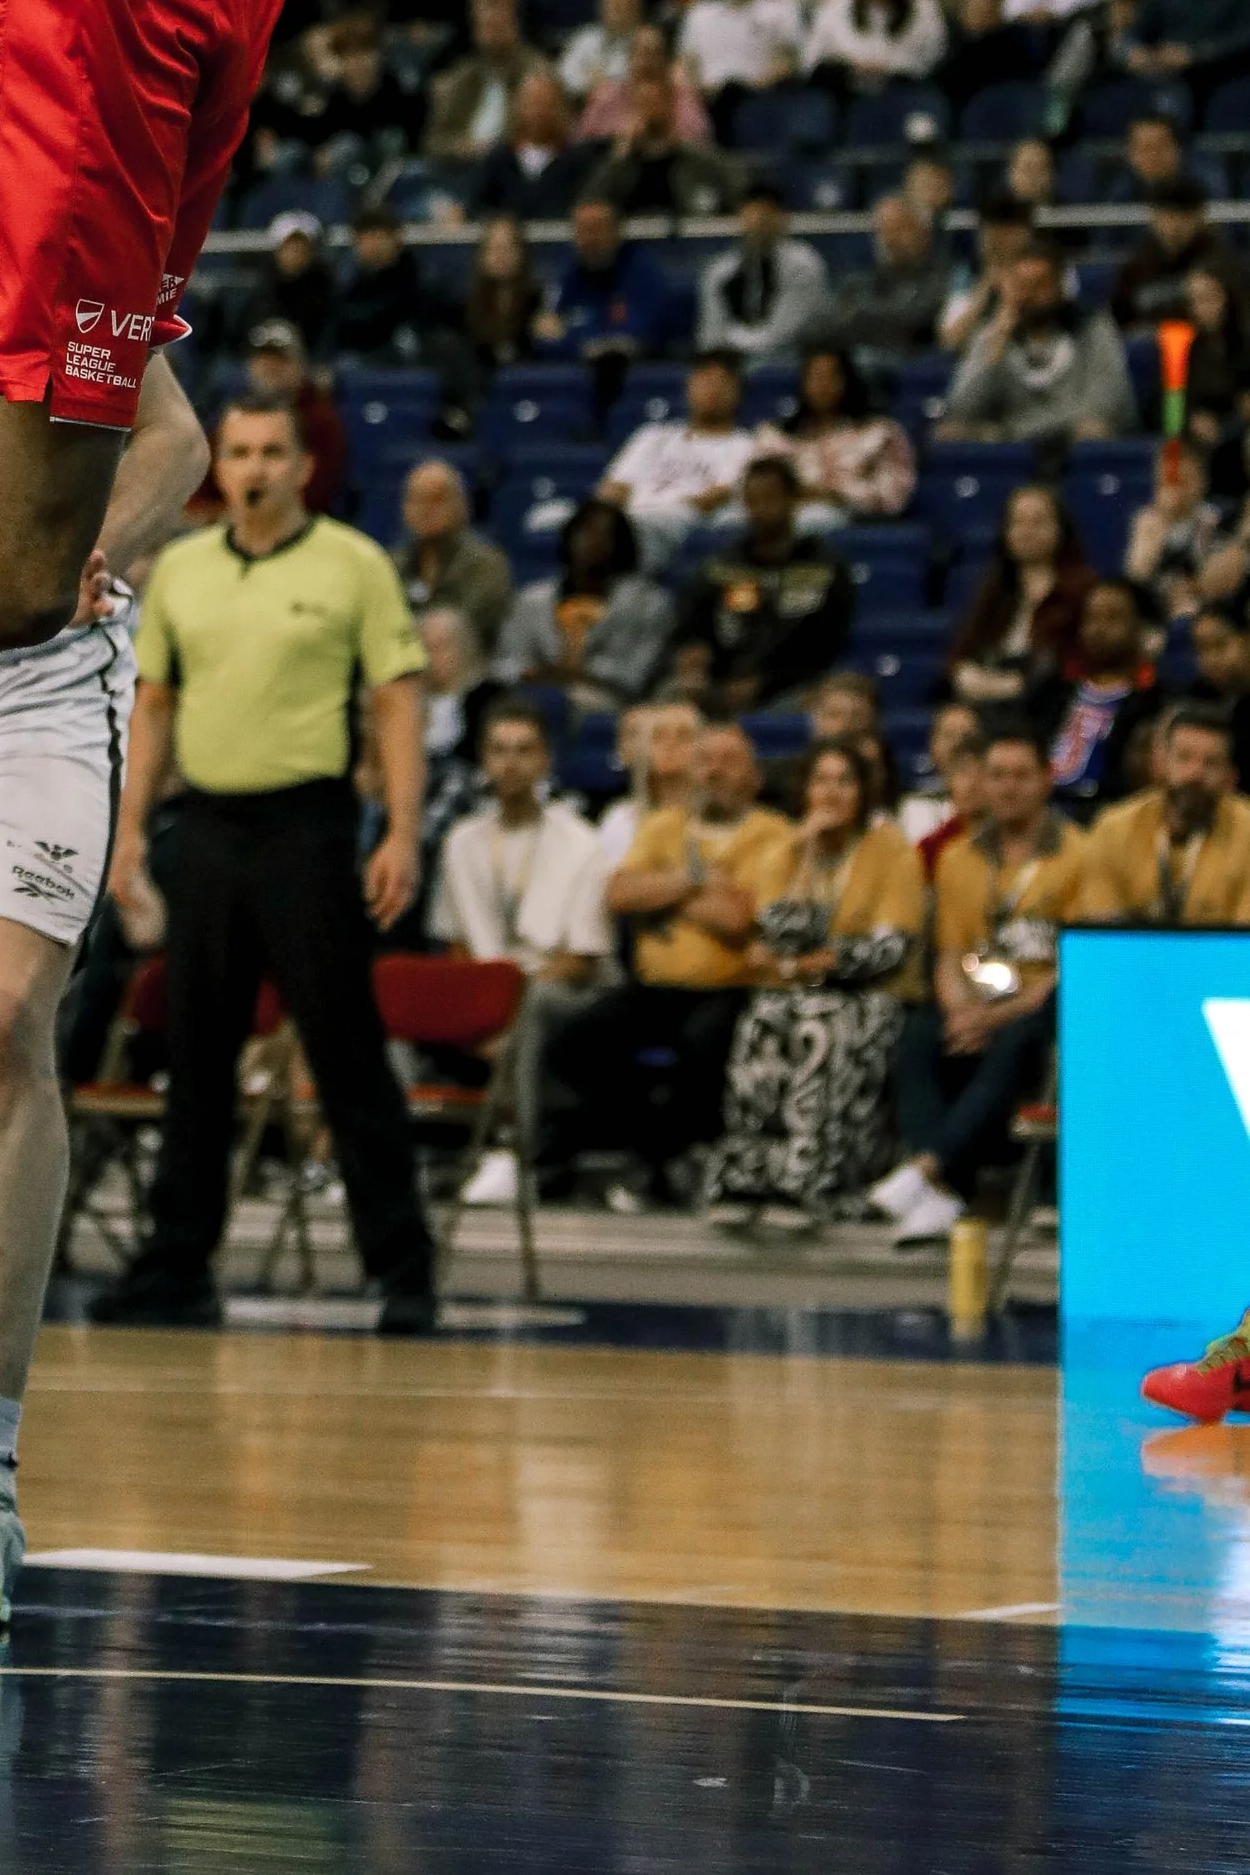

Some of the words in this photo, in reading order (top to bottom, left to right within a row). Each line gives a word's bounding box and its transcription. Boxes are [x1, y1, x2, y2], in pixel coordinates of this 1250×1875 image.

[67, 340, 112, 360] SUPER
[65, 352, 117, 374] LEAGUE
[65, 364, 138, 389] BASKETBALL
[12, 865, 75, 901] Reebok
